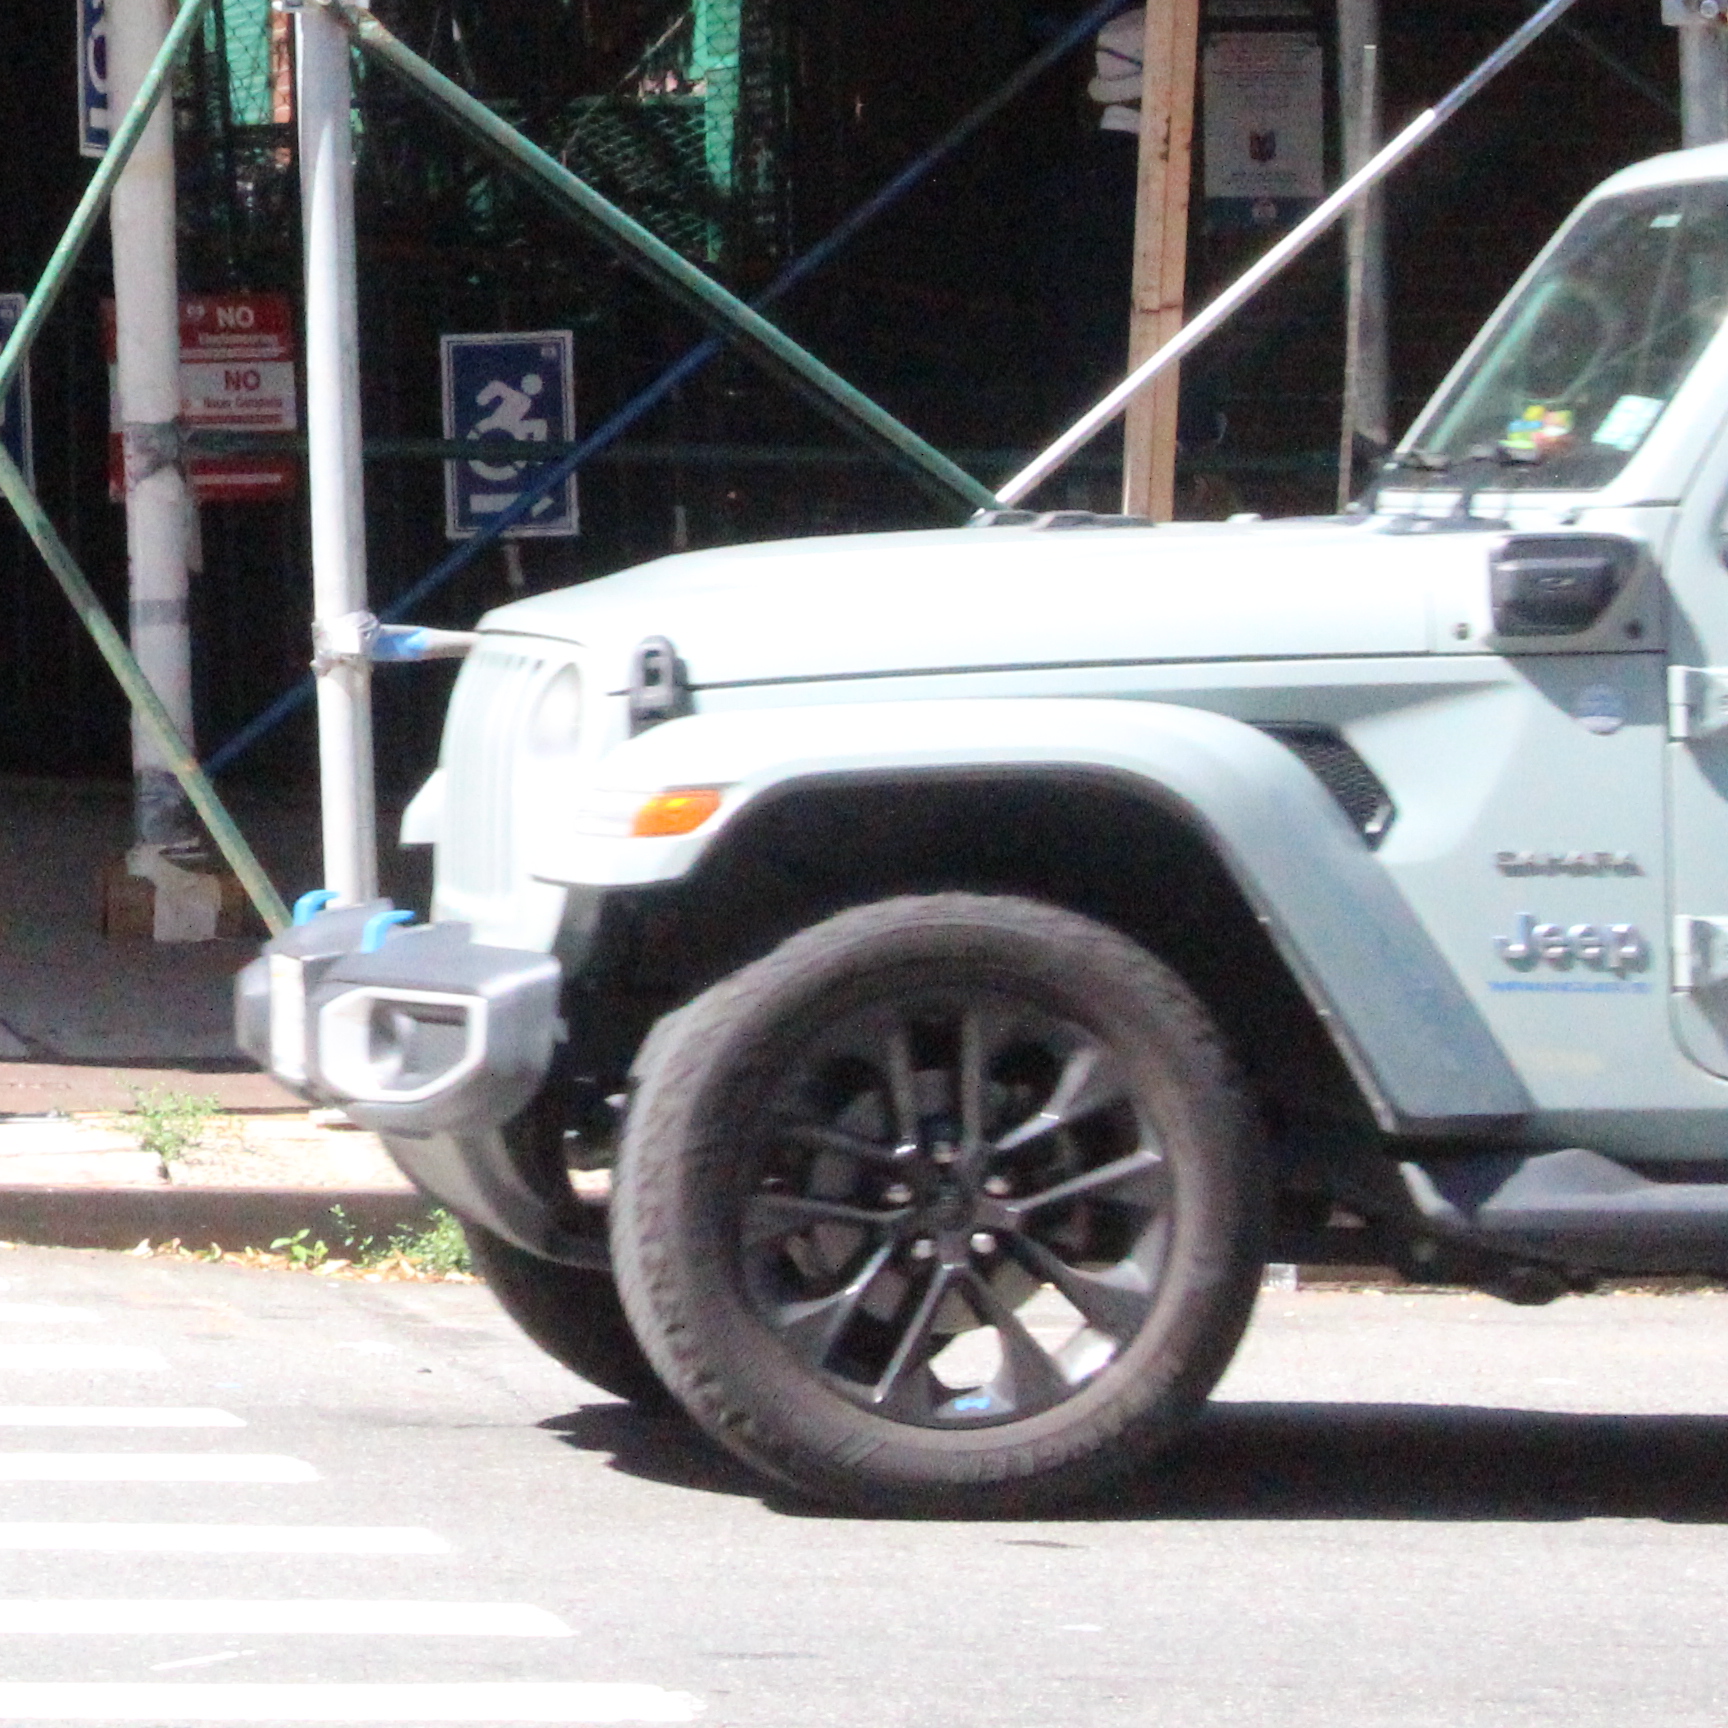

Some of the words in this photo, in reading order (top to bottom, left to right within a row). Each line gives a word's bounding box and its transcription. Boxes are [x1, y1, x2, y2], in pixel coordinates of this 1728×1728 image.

[215, 305, 255, 329] NO
[225, 369, 261, 391] NO
[1491, 911, 1651, 980] Jeep
